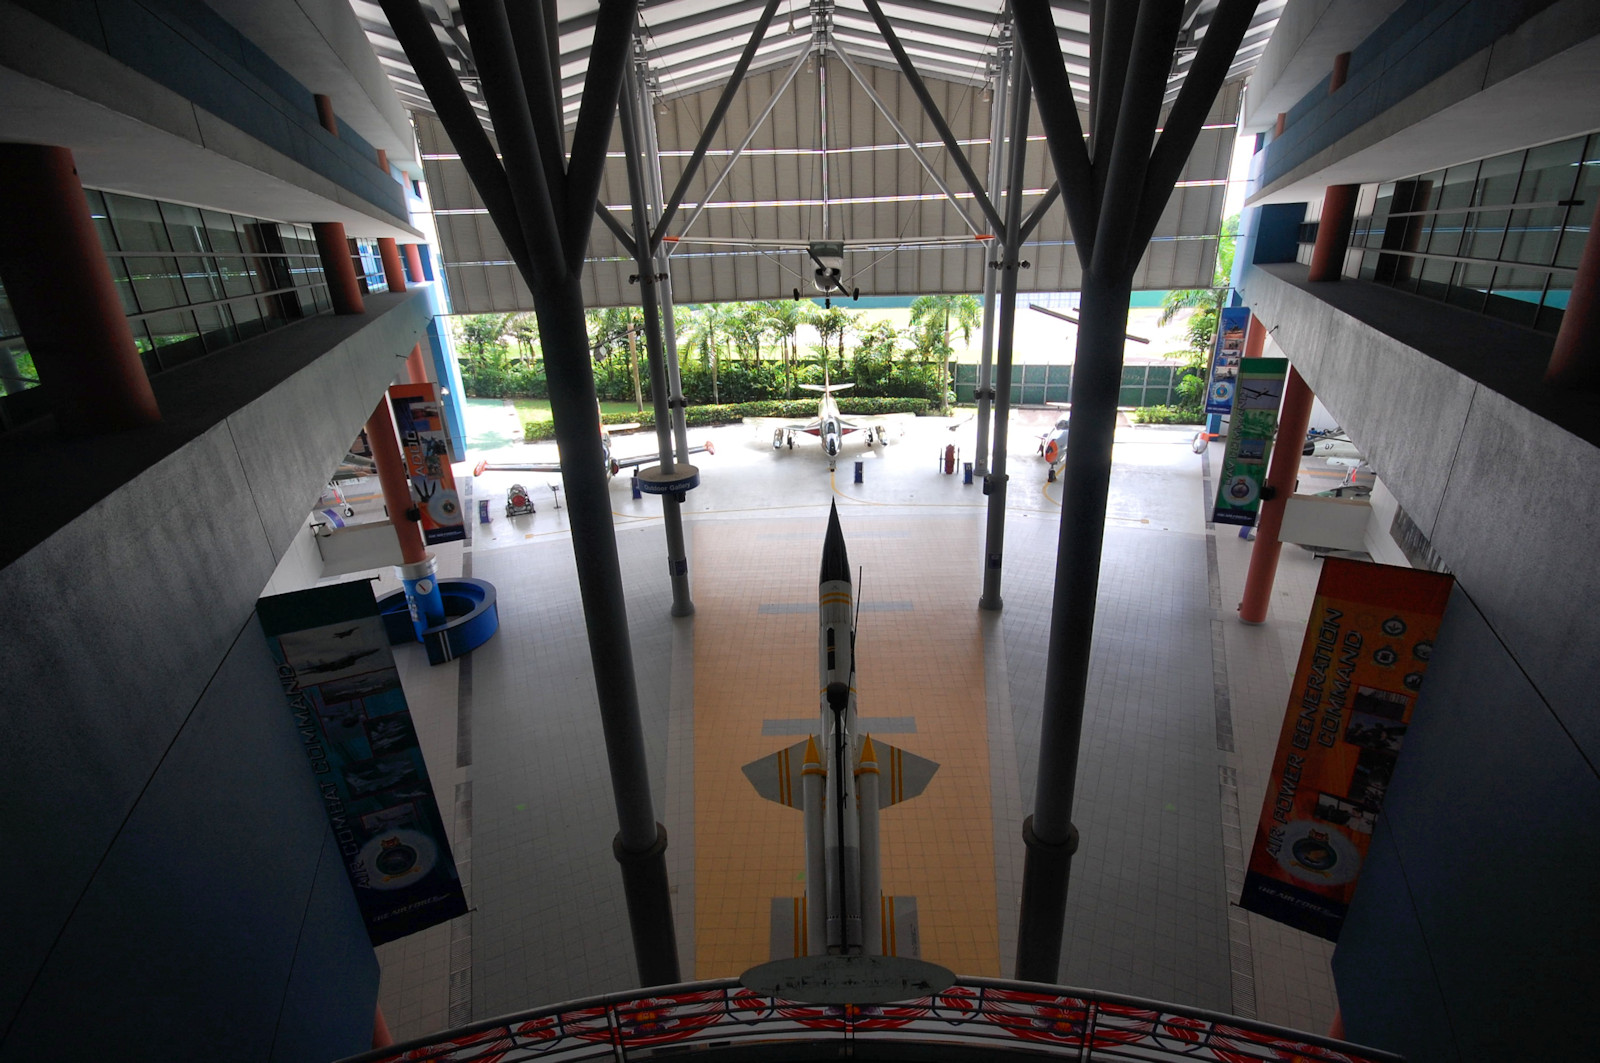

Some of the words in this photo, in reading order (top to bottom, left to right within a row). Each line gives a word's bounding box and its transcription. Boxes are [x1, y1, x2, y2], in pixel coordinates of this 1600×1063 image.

[644, 484, 668, 492] Outdoor
[669, 482, 691, 492] Gallery
[1291, 607, 1344, 752] GENERATION
[1317, 630, 1362, 748] COMMAND
[277, 662, 331, 776] COMMAND
[320, 781, 361, 858] COMBAT
[1274, 754, 1305, 824] POWER
[351, 858, 371, 889] AIR
[1266, 824, 1285, 860] AIR
